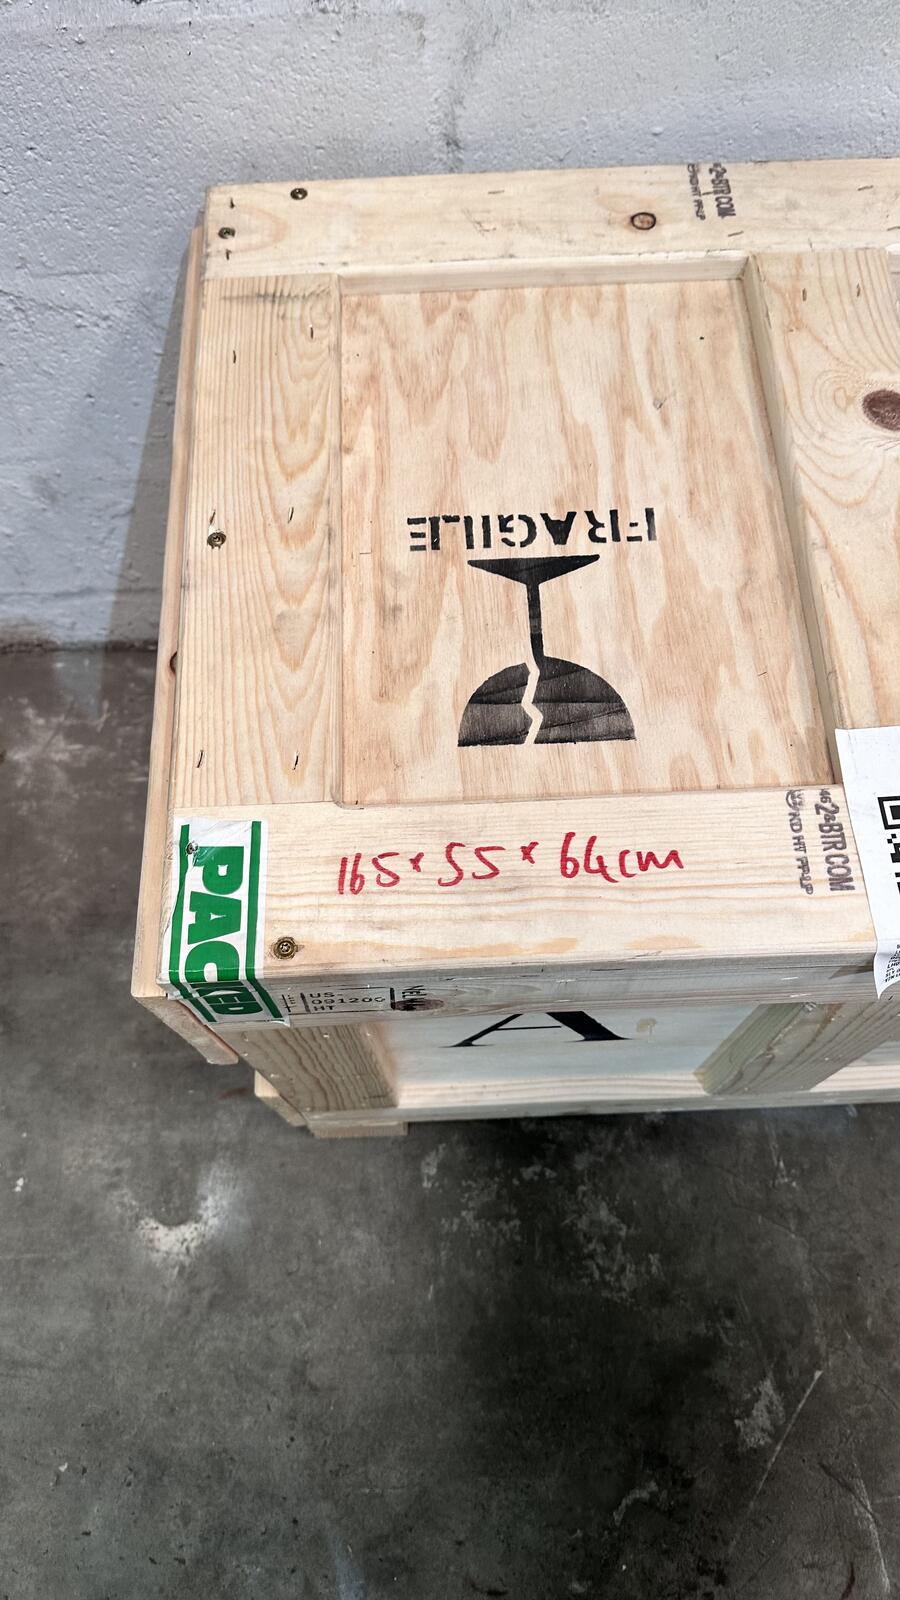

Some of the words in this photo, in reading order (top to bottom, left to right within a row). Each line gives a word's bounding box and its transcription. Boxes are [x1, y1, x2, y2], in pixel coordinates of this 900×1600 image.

[407, 507, 657, 551] FRAGILE
[337, 851, 400, 895] 165
[437, 842, 506, 887] 55
[559, 831, 684, 884] 64cm
[792, 835, 807, 853] HT
[825, 853, 856, 892] COM
[184, 845, 264, 1015] PACKED
[438, 1010, 634, 1049] A
